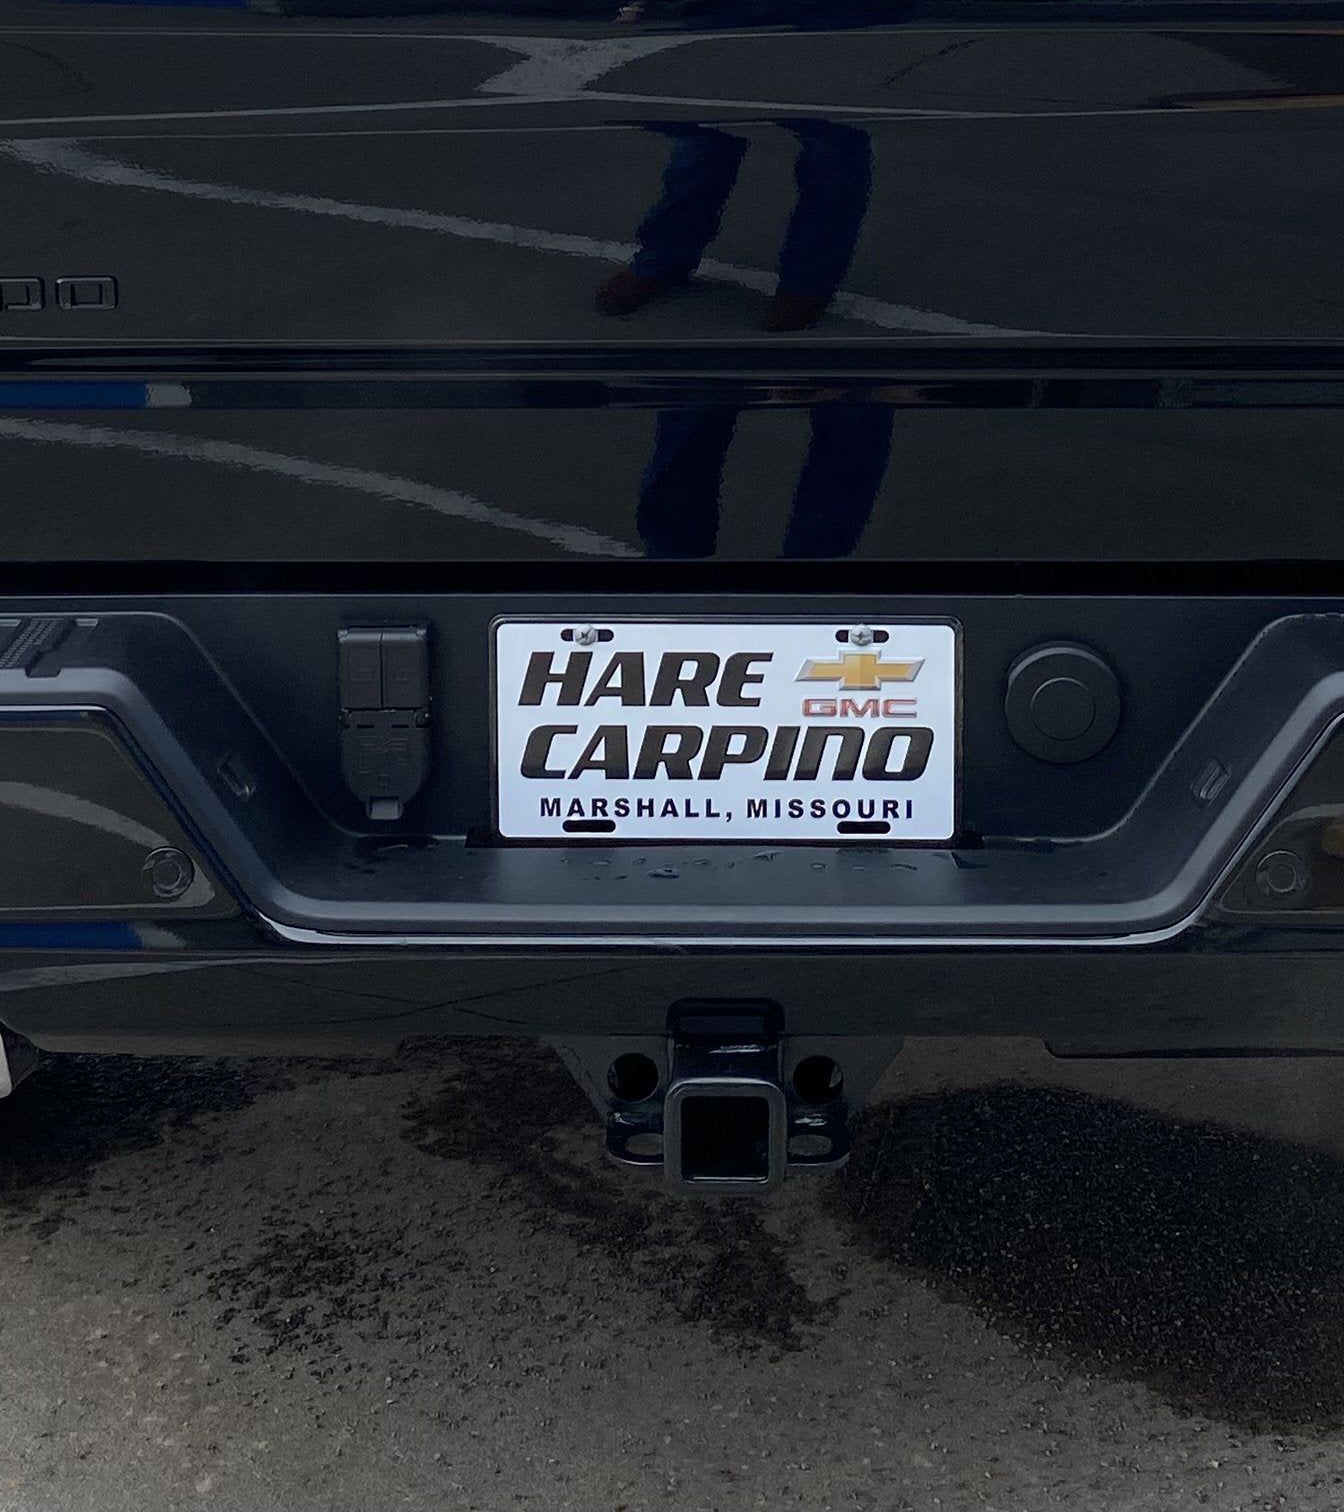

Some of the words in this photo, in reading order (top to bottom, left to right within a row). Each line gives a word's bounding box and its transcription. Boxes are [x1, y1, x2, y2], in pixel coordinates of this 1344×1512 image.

[518, 651, 774, 707] HARE
[801, 698, 918, 718] GMC
[520, 724, 935, 781] CARPINO
[540, 797, 733, 822] MARSHALL,
[746, 798, 914, 819] MISSOURI
